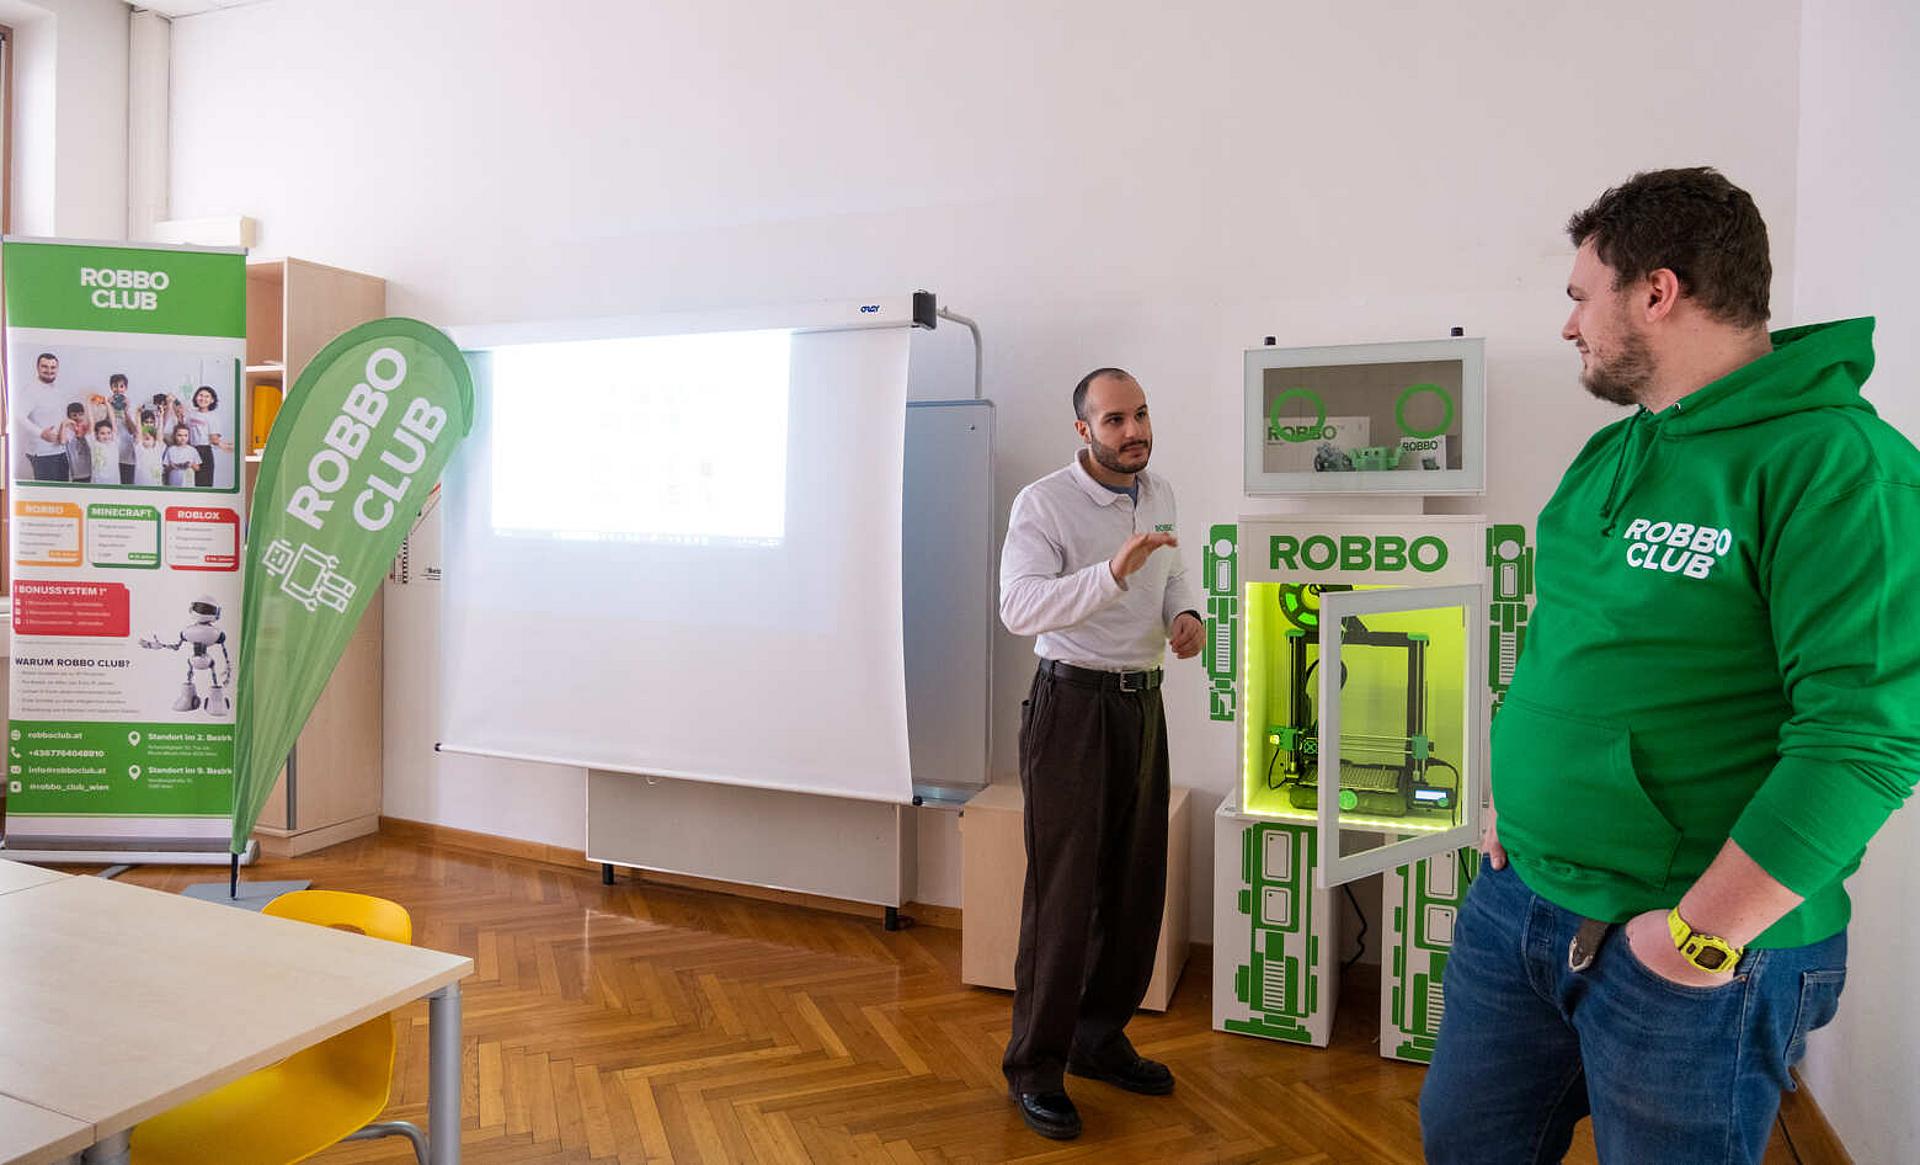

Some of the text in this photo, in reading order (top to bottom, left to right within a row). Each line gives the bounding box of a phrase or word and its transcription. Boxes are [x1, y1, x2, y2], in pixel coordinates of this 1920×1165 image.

[80, 267, 170, 291] ROBBO
[91, 289, 158, 310] CLUB
[286, 347, 408, 530] ROBBO
[1402, 440, 1438, 451] ROBBO
[353, 396, 448, 531] CLUB
[90, 507, 153, 519] MINECRAFT
[177, 509, 221, 520] ROBLOX
[1623, 518, 1732, 556] ROBBO
[1269, 535, 1449, 573] ROBBO
[1626, 542, 1715, 580] CLUB
[19, 585, 97, 596] BONUSSYSTEM
[15, 657, 131, 668] WARUM ROBBO CLUB?
